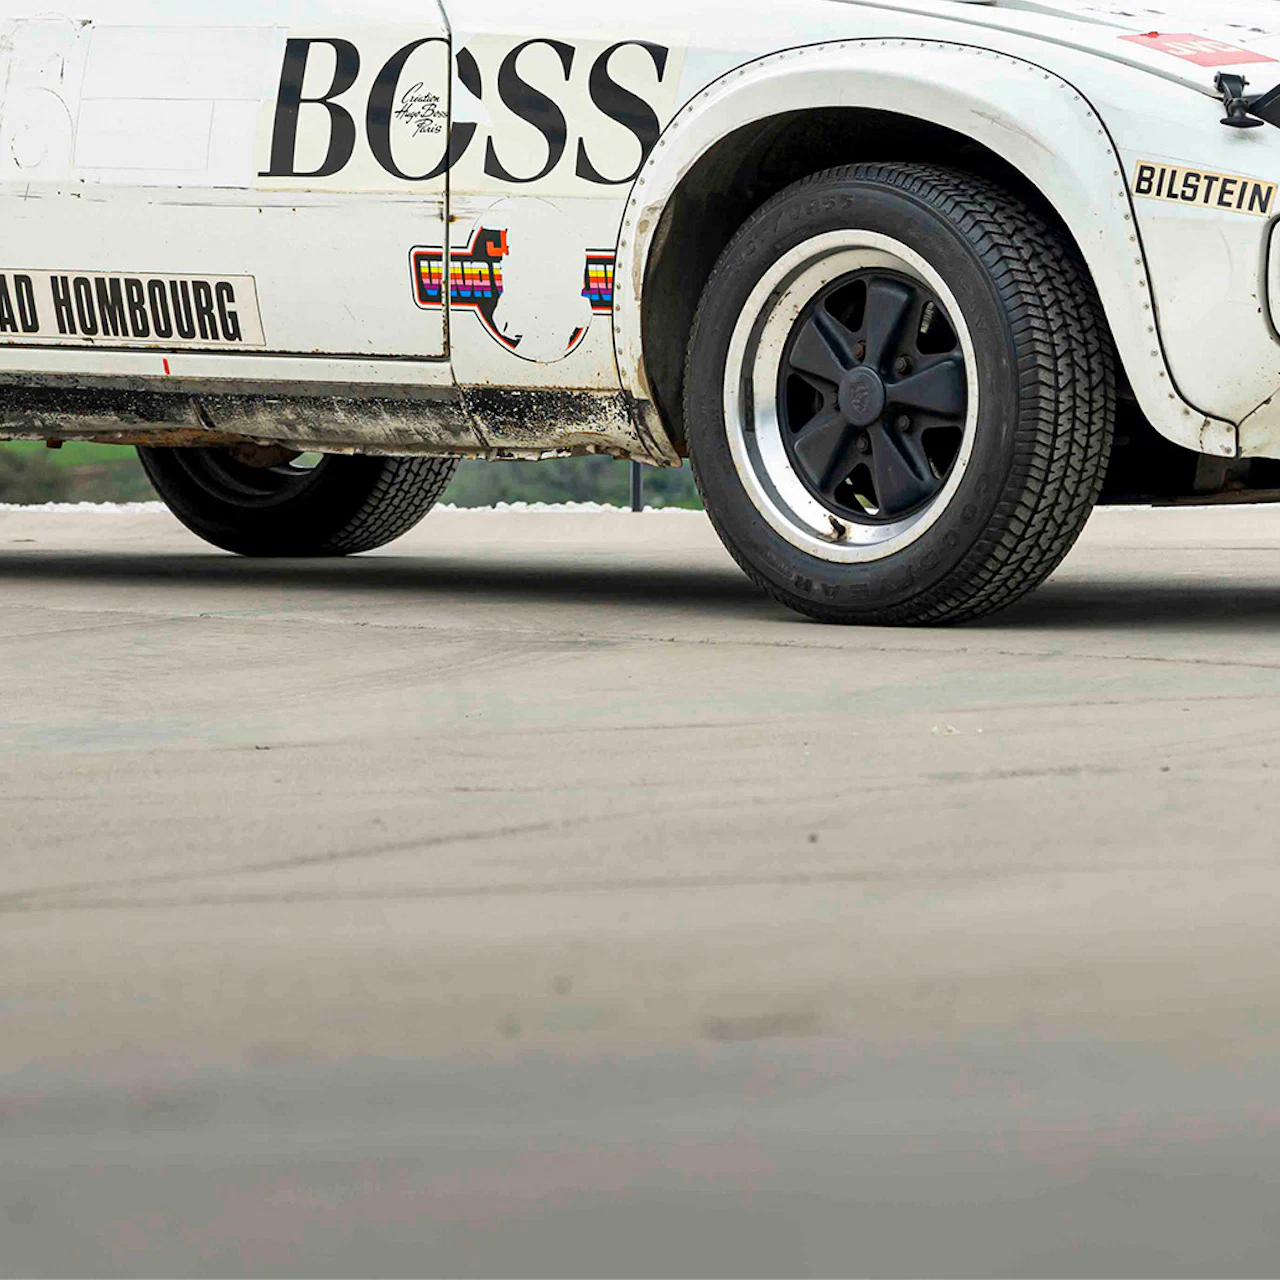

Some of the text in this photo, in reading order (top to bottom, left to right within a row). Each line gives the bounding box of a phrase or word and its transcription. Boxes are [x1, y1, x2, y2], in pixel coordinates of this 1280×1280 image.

[257, 37, 669, 185] BOSS
[394, 102, 449, 125] Hugo Boss
[412, 117, 442, 138] Paris
[1134, 164, 1275, 215] BILSTEIN
[50, 275, 243, 342] HOMBOURG
